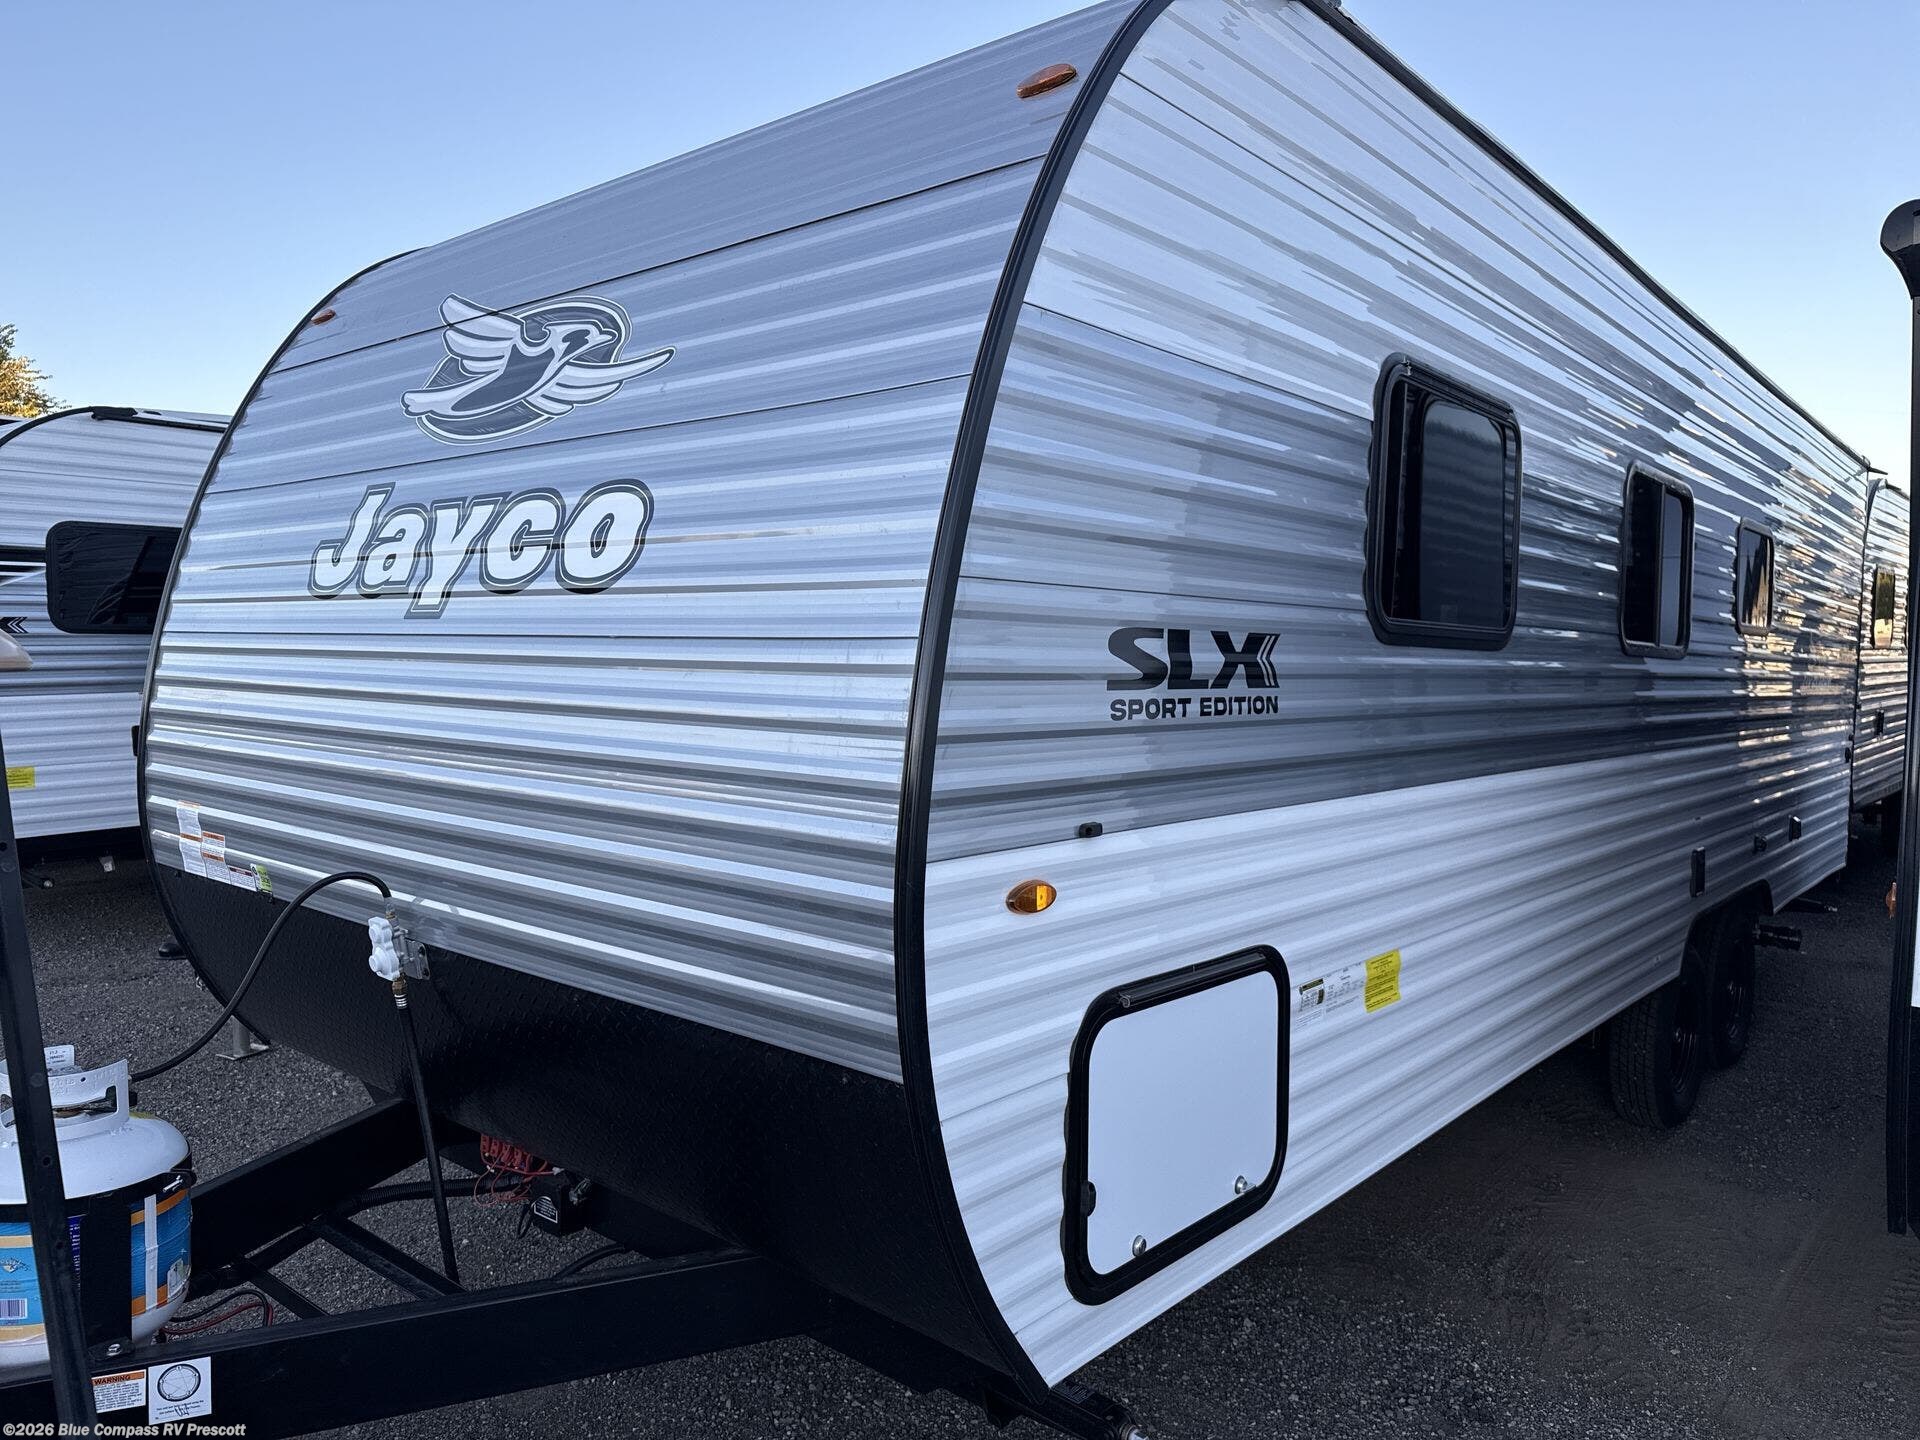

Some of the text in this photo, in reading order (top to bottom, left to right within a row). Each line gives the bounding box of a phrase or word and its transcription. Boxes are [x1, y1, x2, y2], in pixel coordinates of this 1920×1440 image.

[307, 478, 655, 620] Jayco
[1106, 626, 1281, 691] SLX
[1110, 695, 1278, 721] SPORT EDITION
[94, 1374, 131, 1385] WARNING
